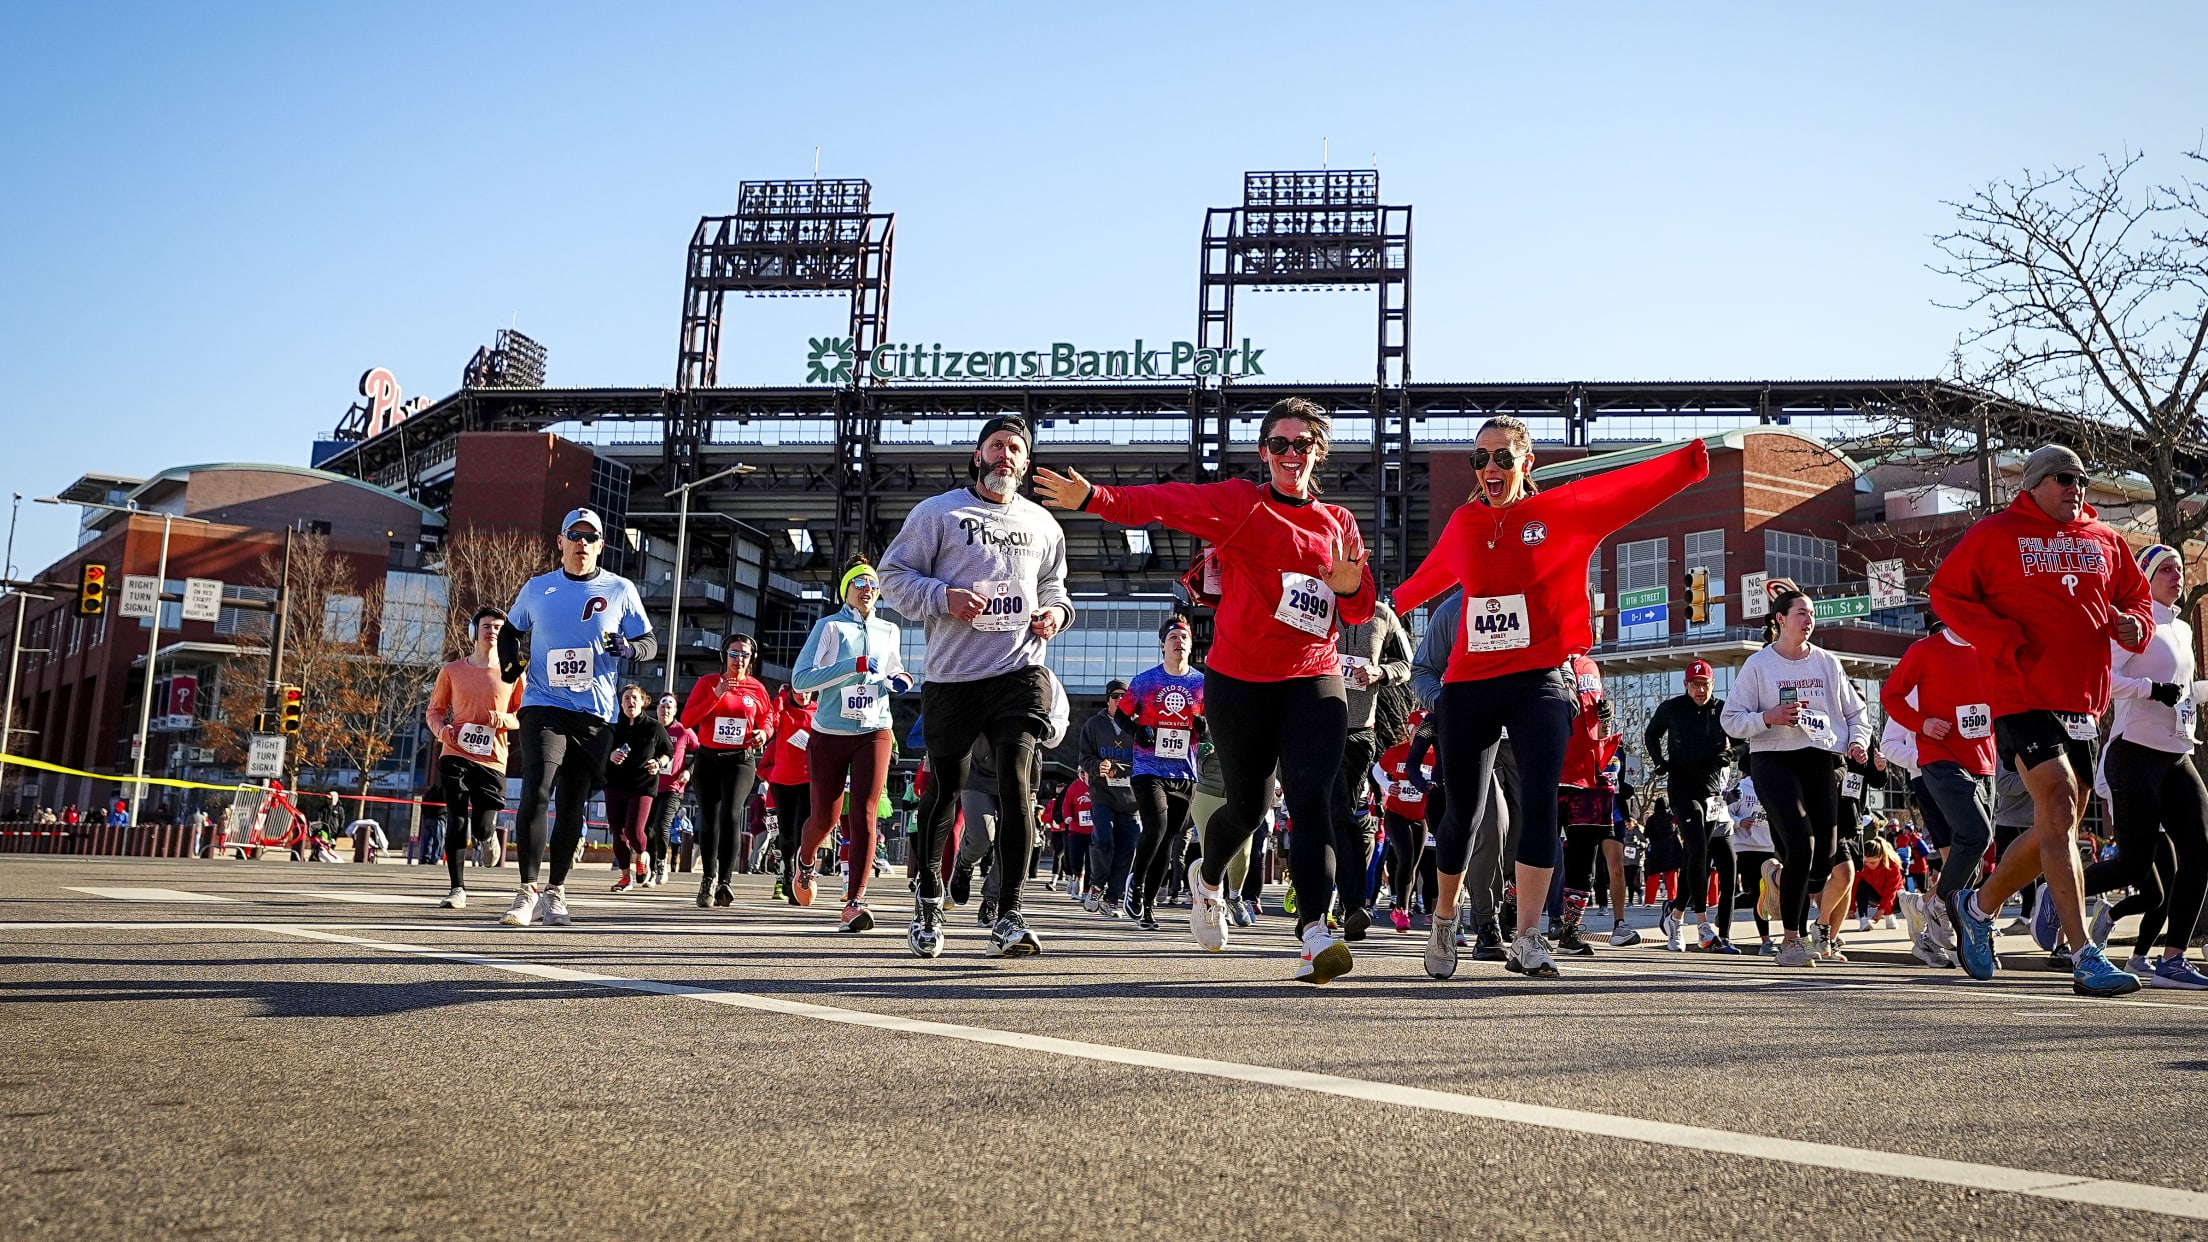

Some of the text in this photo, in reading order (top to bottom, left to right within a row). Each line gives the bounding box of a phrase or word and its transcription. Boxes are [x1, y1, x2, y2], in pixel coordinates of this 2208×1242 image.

[870, 337, 1266, 378] Citizens Bank Park
[2018, 537, 2104, 553] PHILADELPHIA
[2021, 553, 2106, 575] PHILLIES
[128, 580, 154, 590] RIGHT
[2061, 574, 2079, 596] P
[129, 591, 152, 601] TURN
[1640, 592, 1660, 603] STREET
[1747, 589, 1763, 597] TURN
[123, 602, 153, 613] SIGNAL
[581, 596, 608, 622] P
[981, 596, 1023, 616] 2080
[1288, 589, 1329, 619] 2999
[1814, 601, 1851, 616] 11th St
[1873, 597, 1887, 607] THE
[1750, 607, 1762, 615] RED
[1474, 612, 1520, 634] 4424
[553, 660, 587, 675] 1392
[1155, 685, 1194, 705] UNITED STATES
[1801, 714, 1825, 731] 5744
[1961, 714, 1988, 729] 5509
[718, 725, 742, 736] 5325
[256, 740, 280, 749] RIGHT
[462, 732, 490, 746] 2060
[1162, 737, 1184, 749] 5115
[257, 752, 277, 761] TURN
[251, 762, 279, 772] SIGNAL
